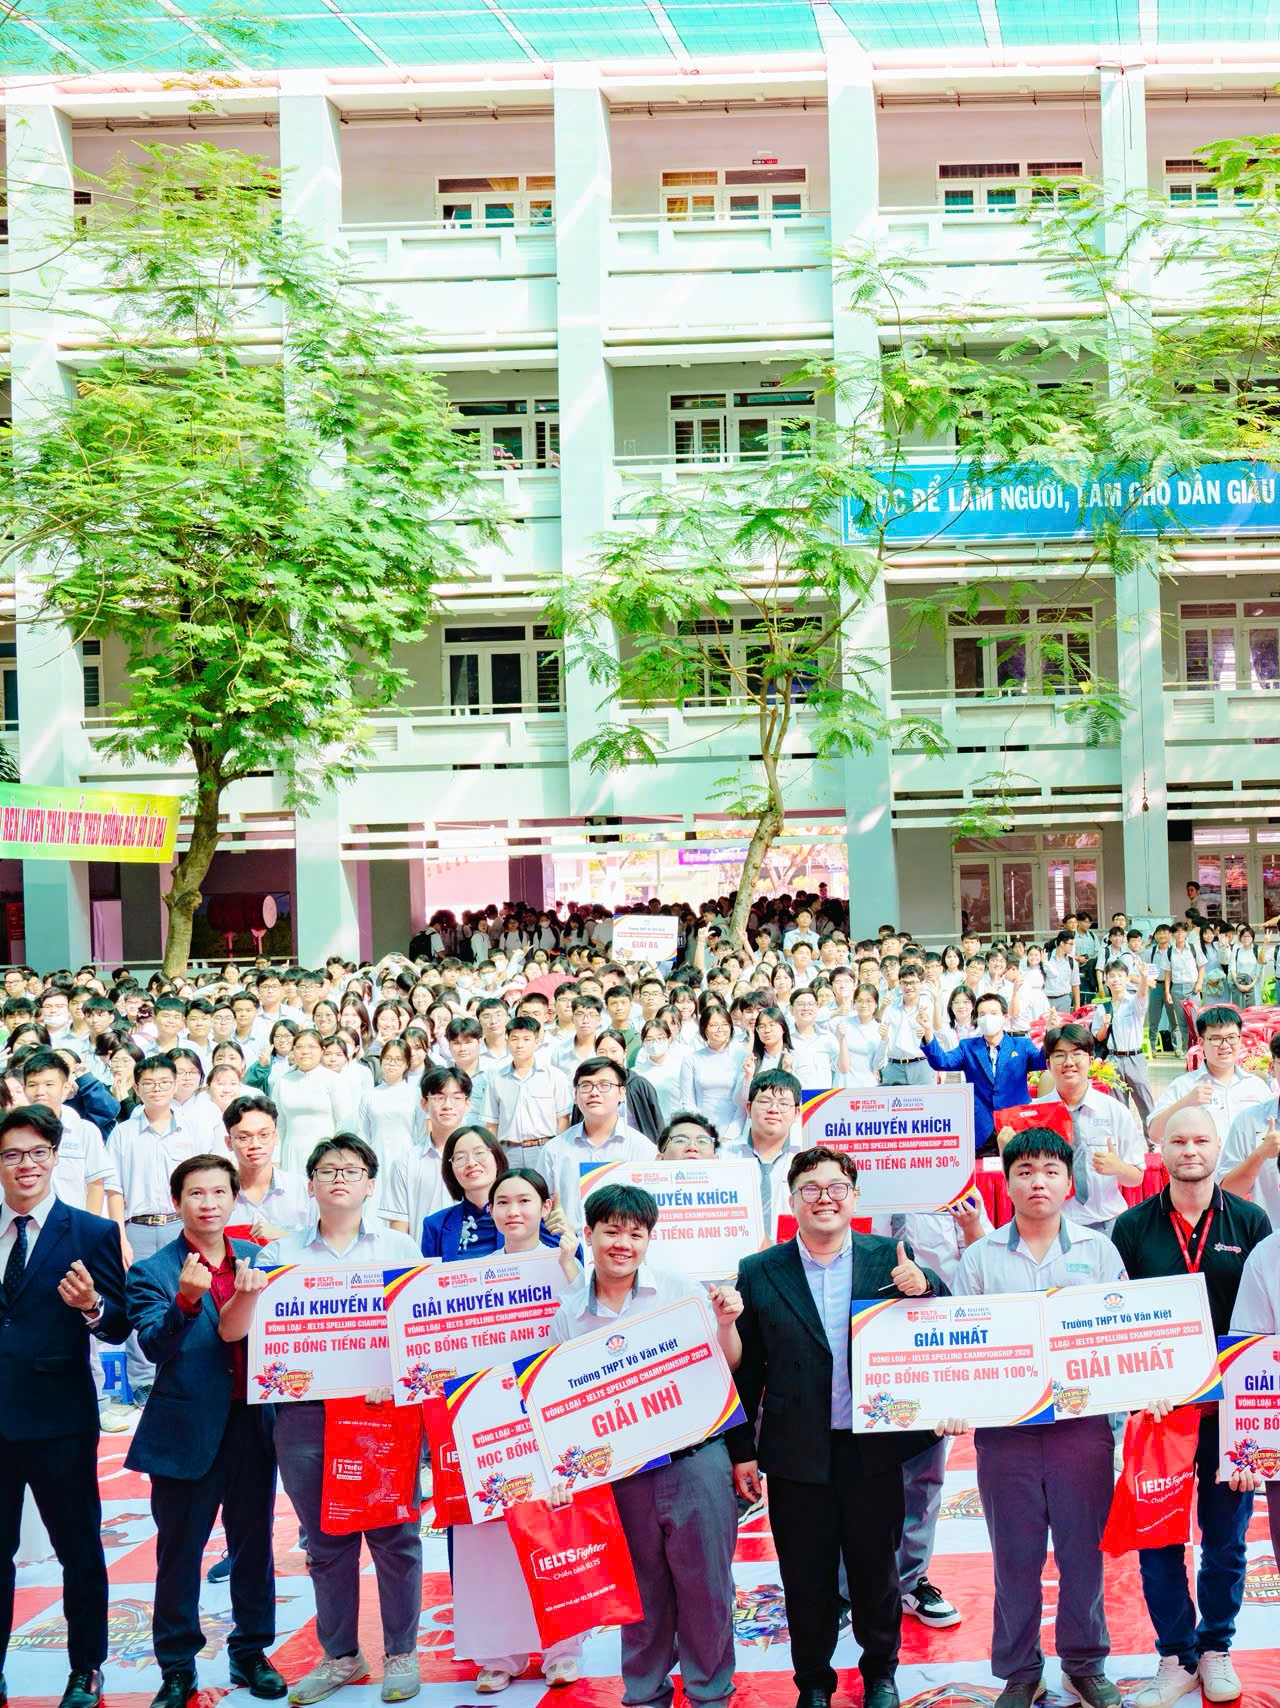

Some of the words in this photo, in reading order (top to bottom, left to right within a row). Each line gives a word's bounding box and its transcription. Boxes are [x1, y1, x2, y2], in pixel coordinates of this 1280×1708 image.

[911, 475, 941, 512] ĐỂ
[1129, 482, 1170, 506] CHO
[1178, 474, 1221, 504] DÂN
[1227, 474, 1274, 504] GIÀU
[825, 1118, 851, 1137] GIẢI
[855, 1116, 908, 1136] KHUYẾN
[912, 1116, 951, 1134] KHÍCH
[853, 1142, 869, 1150] IELTS
[875, 1154, 907, 1170] TIẾNG
[910, 1157, 933, 1169] ANH
[935, 1155, 960, 1168] 30%
[697, 1188, 738, 1205] KHÍCH
[660, 1224, 694, 1241] TIẾNG
[698, 1226, 721, 1239] ANH
[723, 1225, 750, 1238] 30%
[451, 1273, 468, 1281] IELTS
[451, 1277, 477, 1286] FIGHTER
[275, 1296, 305, 1317] GIẢI
[310, 1294, 368, 1315] KHUYẾN
[412, 1296, 442, 1319] GIẢI
[446, 1288, 505, 1314] KHUYẾN
[509, 1284, 553, 1305] KHÍCH
[307, 1321, 325, 1330] IELTS
[326, 1320, 357, 1330] SPELLING
[446, 1319, 463, 1329] IELTS
[464, 1314, 495, 1327] SPELLING
[495, 1309, 543, 1322] CHAMPIONSHIP
[1062, 1318, 1093, 1330] Trường
[1095, 1315, 1118, 1326] THPT
[1153, 1309, 1172, 1322] Kiệt
[264, 1342, 290, 1358] HỌC
[294, 1336, 327, 1354] BỔNG
[331, 1334, 366, 1352] TIẾNG
[406, 1343, 431, 1359] HỌC
[434, 1334, 468, 1353] BỔNG
[471, 1330, 506, 1348] TIẾNG
[510, 1327, 535, 1343] ANH
[914, 1328, 944, 1348] GIẢI
[949, 1324, 989, 1346] NHẤT
[1076, 1337, 1095, 1346] IELTS
[1096, 1333, 1128, 1344] SPELLING
[1129, 1327, 1181, 1340] CHAMPIONSHIP
[568, 1370, 601, 1389] Trường
[601, 1359, 625, 1376] THPT
[658, 1337, 679, 1354] Kiệt
[912, 1353, 930, 1362] IELTS
[931, 1352, 963, 1361] SPELLING
[963, 1349, 1013, 1360] CHAMPIONSHIP
[1066, 1350, 1111, 1381] GIẢI
[1117, 1342, 1175, 1375] NHẤT
[586, 1390, 606, 1403] IELTS
[606, 1375, 639, 1394] SPELLING
[639, 1356, 691, 1381] CHAMPIONSHIP
[865, 1373, 891, 1388] HỌC
[894, 1366, 929, 1384] BỔNG
[933, 1365, 969, 1383] TIẾNG
[973, 1367, 999, 1381] ANH
[1003, 1364, 1038, 1379] 100%
[1245, 1370, 1274, 1391] GIẢI
[591, 1398, 639, 1438] GIẢI
[641, 1380, 683, 1419] NHÌ
[1235, 1417, 1260, 1434] HỌC
[476, 1450, 503, 1469] HỌC
[506, 1438, 540, 1461] BỔNG
